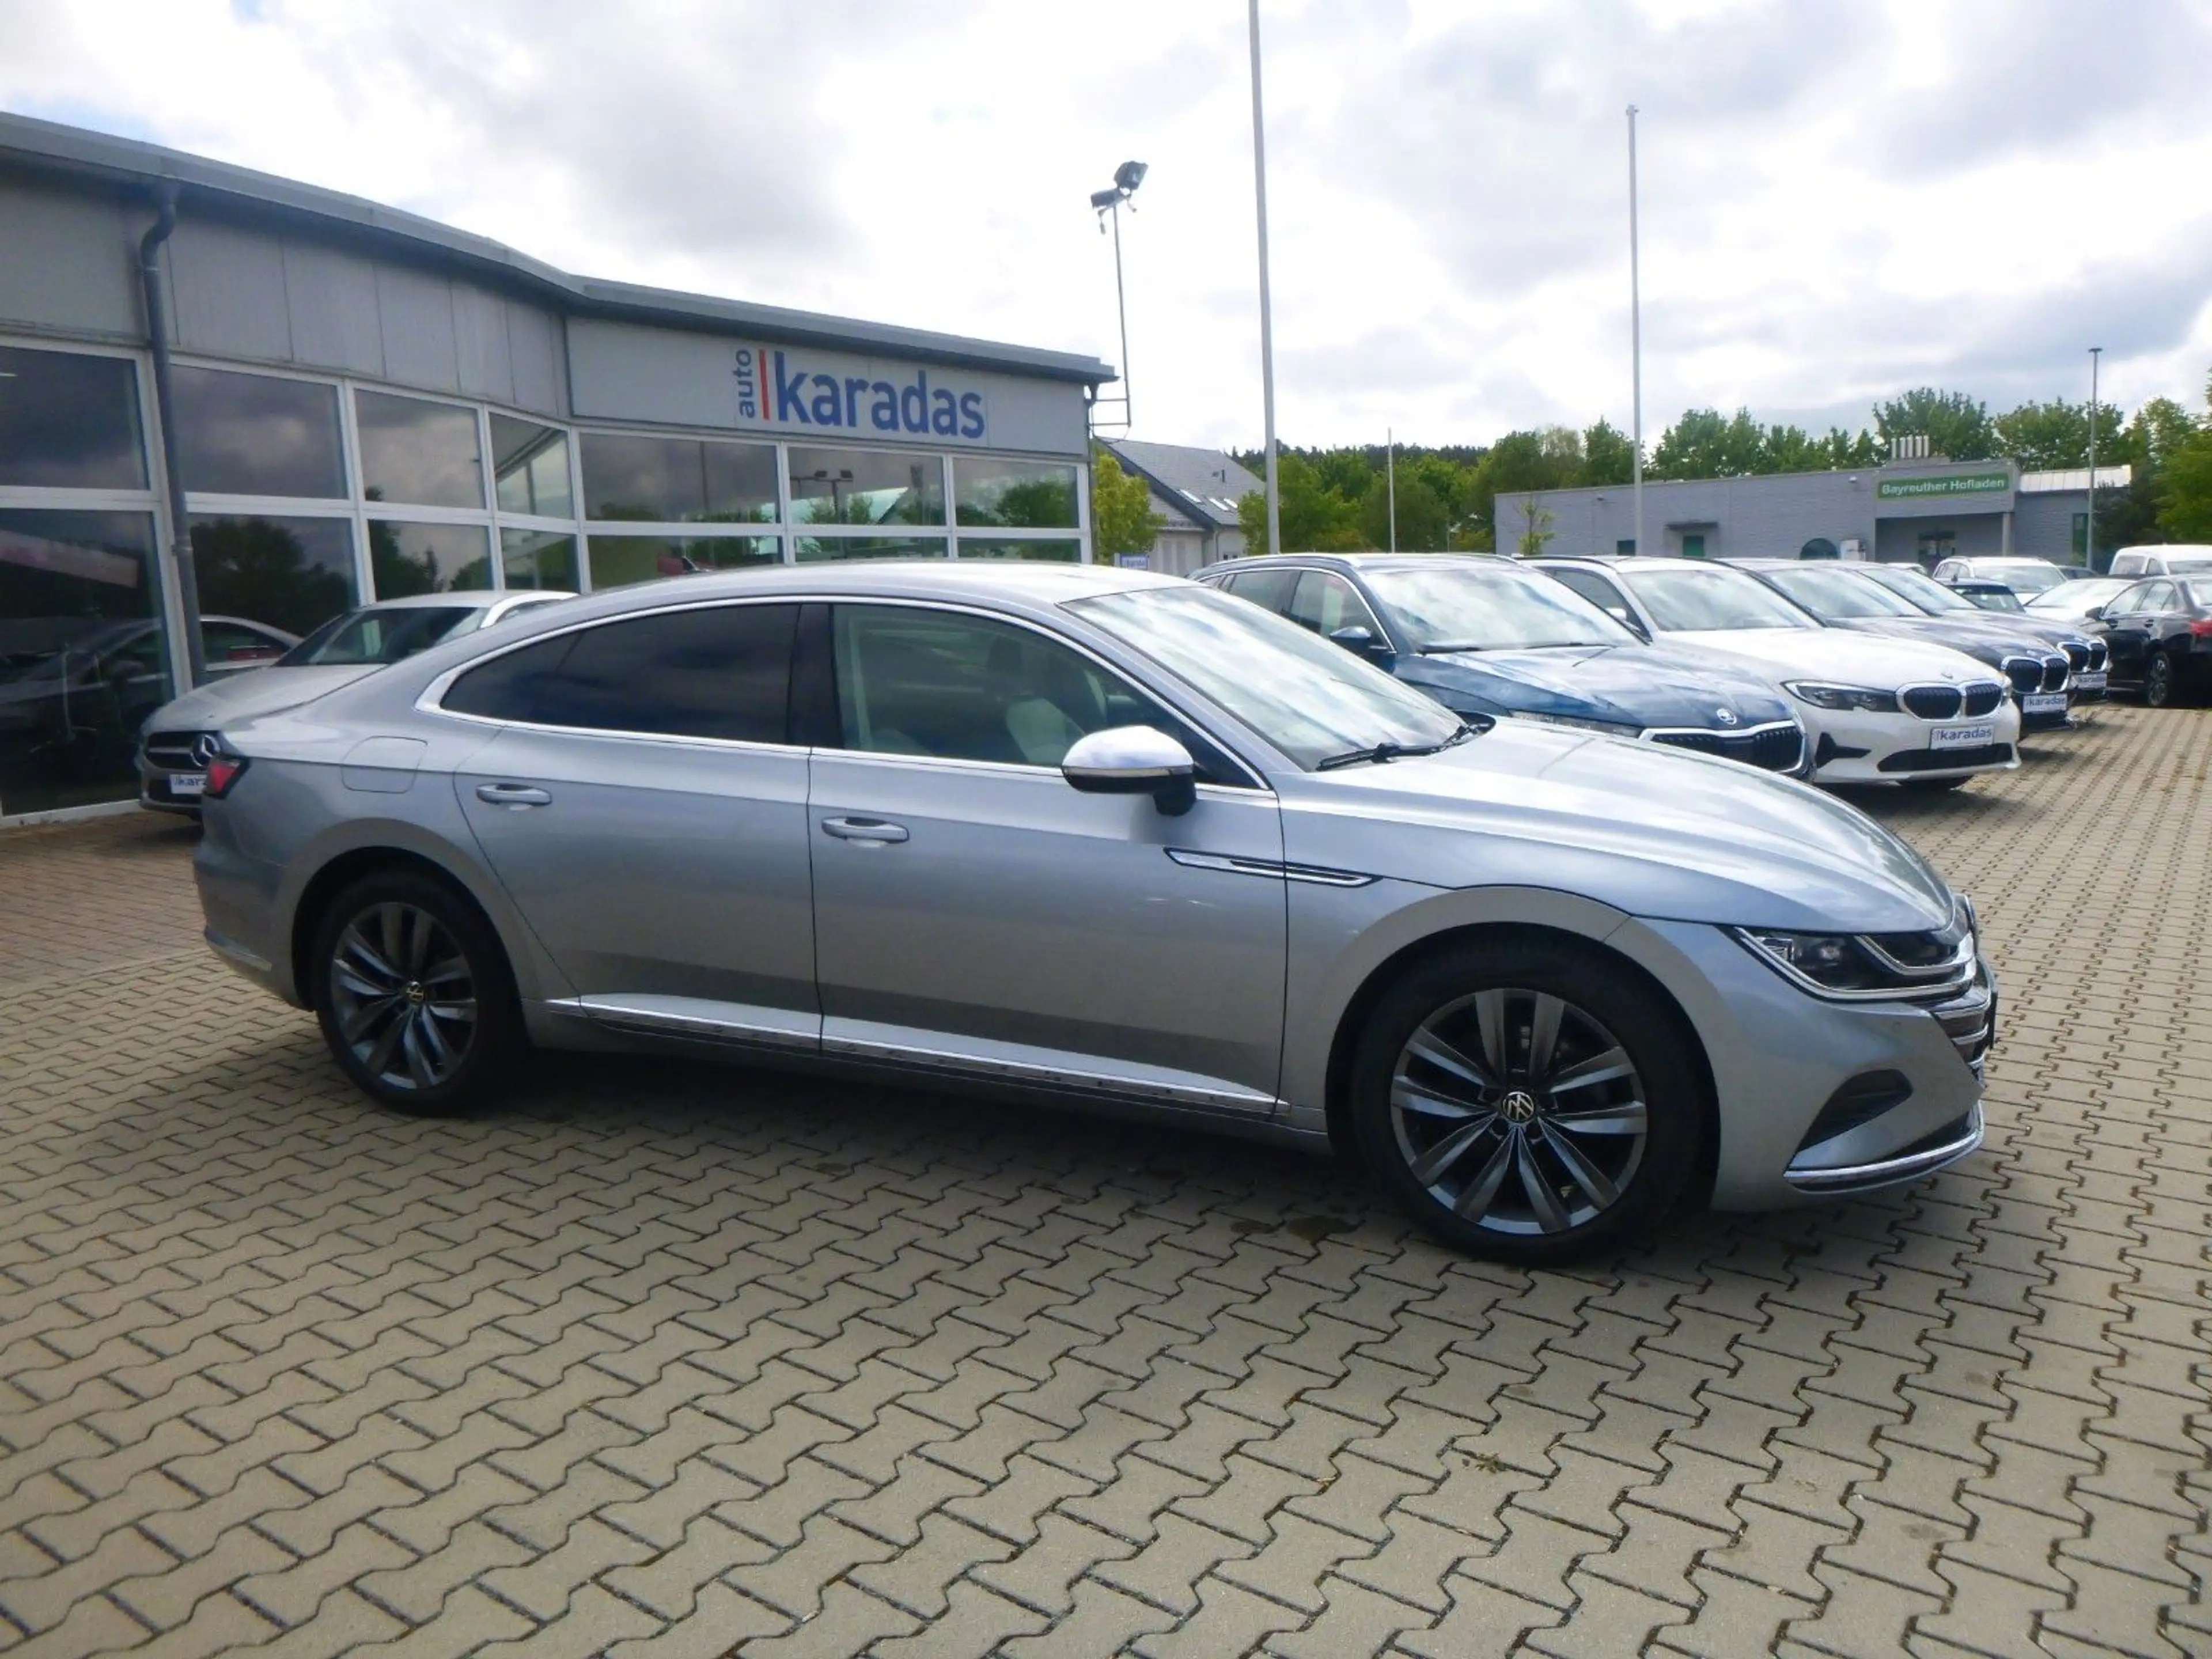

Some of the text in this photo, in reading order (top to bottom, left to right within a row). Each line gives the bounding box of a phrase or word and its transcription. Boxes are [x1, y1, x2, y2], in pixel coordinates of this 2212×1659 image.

[732, 349, 756, 419] auto
[774, 350, 985, 438] karadas
[1882, 479, 2005, 497] Bayreuther Hofladen
[1940, 727, 1992, 741] karadas
